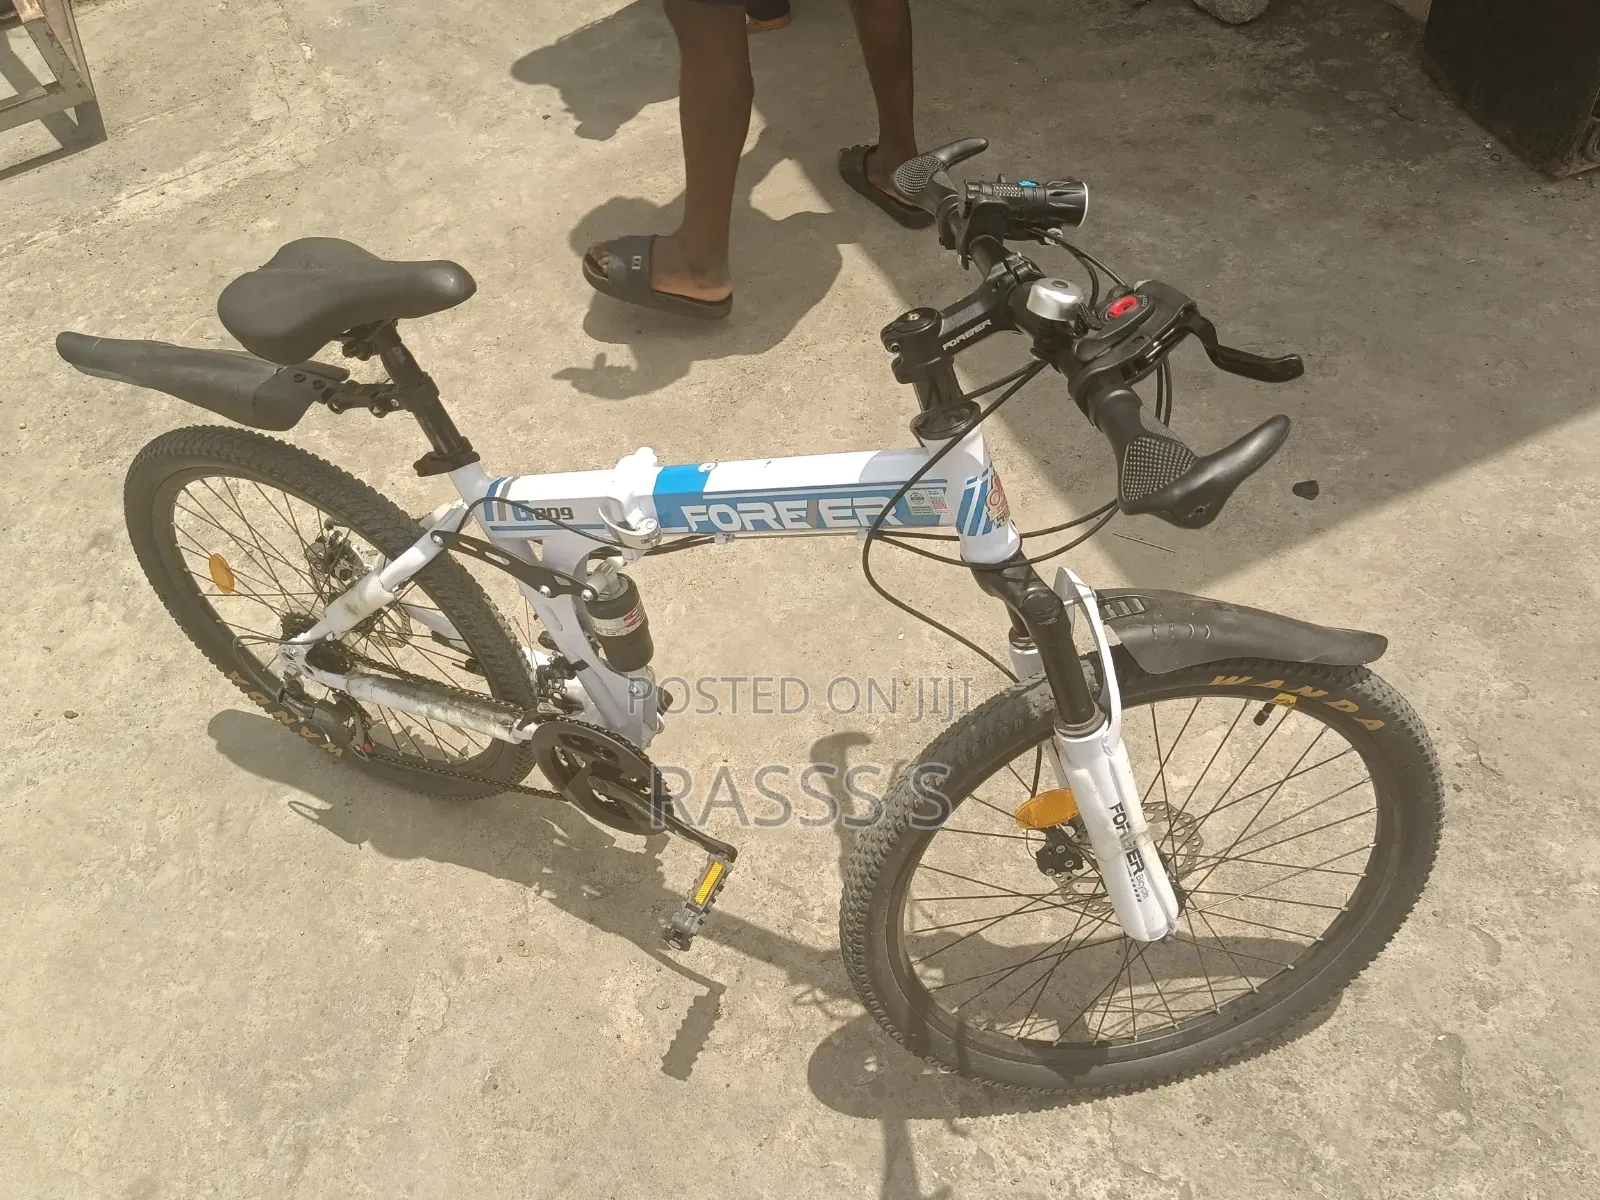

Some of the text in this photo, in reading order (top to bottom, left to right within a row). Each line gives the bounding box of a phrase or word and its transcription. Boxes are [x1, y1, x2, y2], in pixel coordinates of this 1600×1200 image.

[681, 496, 904, 532] FOREER
[1208, 675, 1386, 731] WANDA
[1108, 801, 1150, 899] FORER Bicycle
